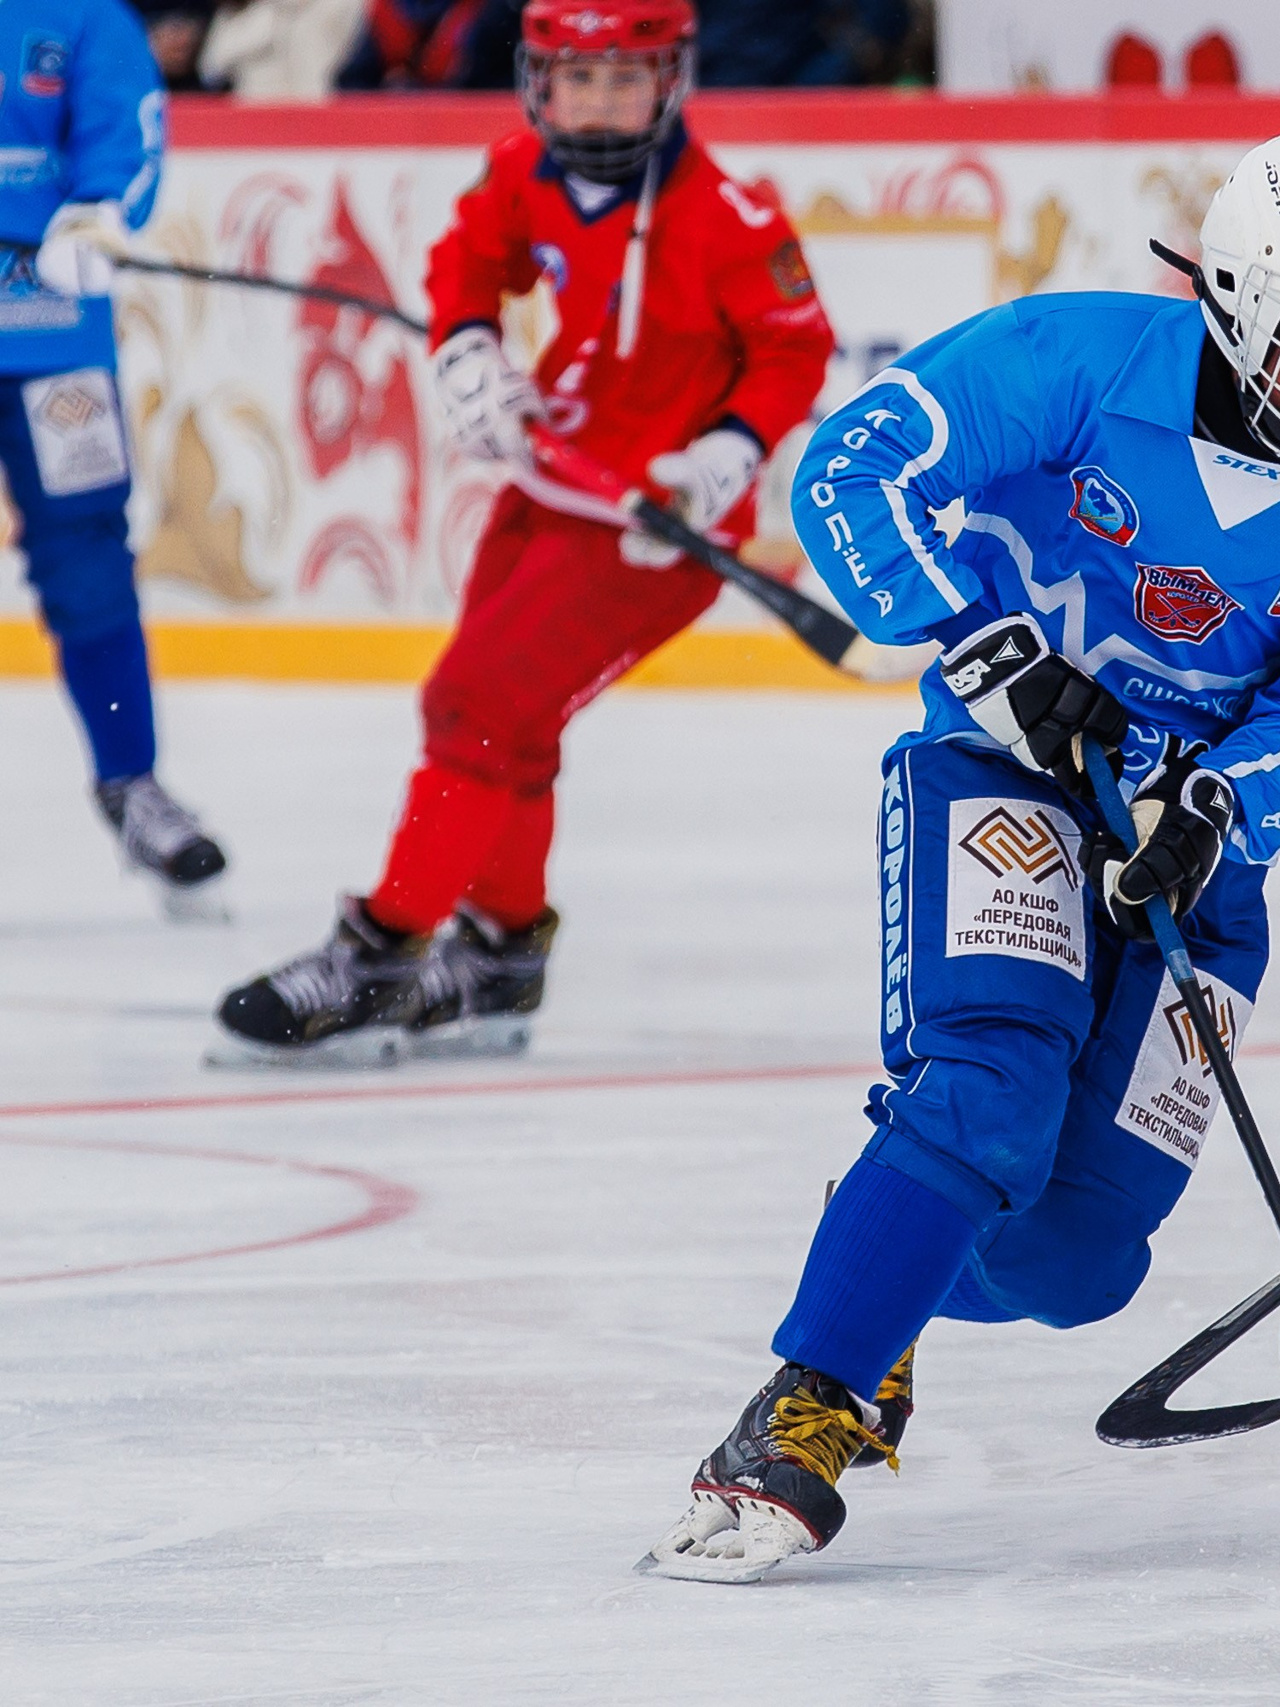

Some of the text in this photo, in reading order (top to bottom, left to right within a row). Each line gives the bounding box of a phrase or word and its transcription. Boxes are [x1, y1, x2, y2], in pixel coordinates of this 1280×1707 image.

[884, 763, 908, 1035] КОРОЛЁВ
[992, 889, 1059, 913] АО КШФ
[973, 908, 1071, 941] «ПЕРЕДОВАЯ
[955, 930, 1082, 968] ТЕКСТИЛЬЩИЦА»
[1171, 1076, 1211, 1109] АО КШФ
